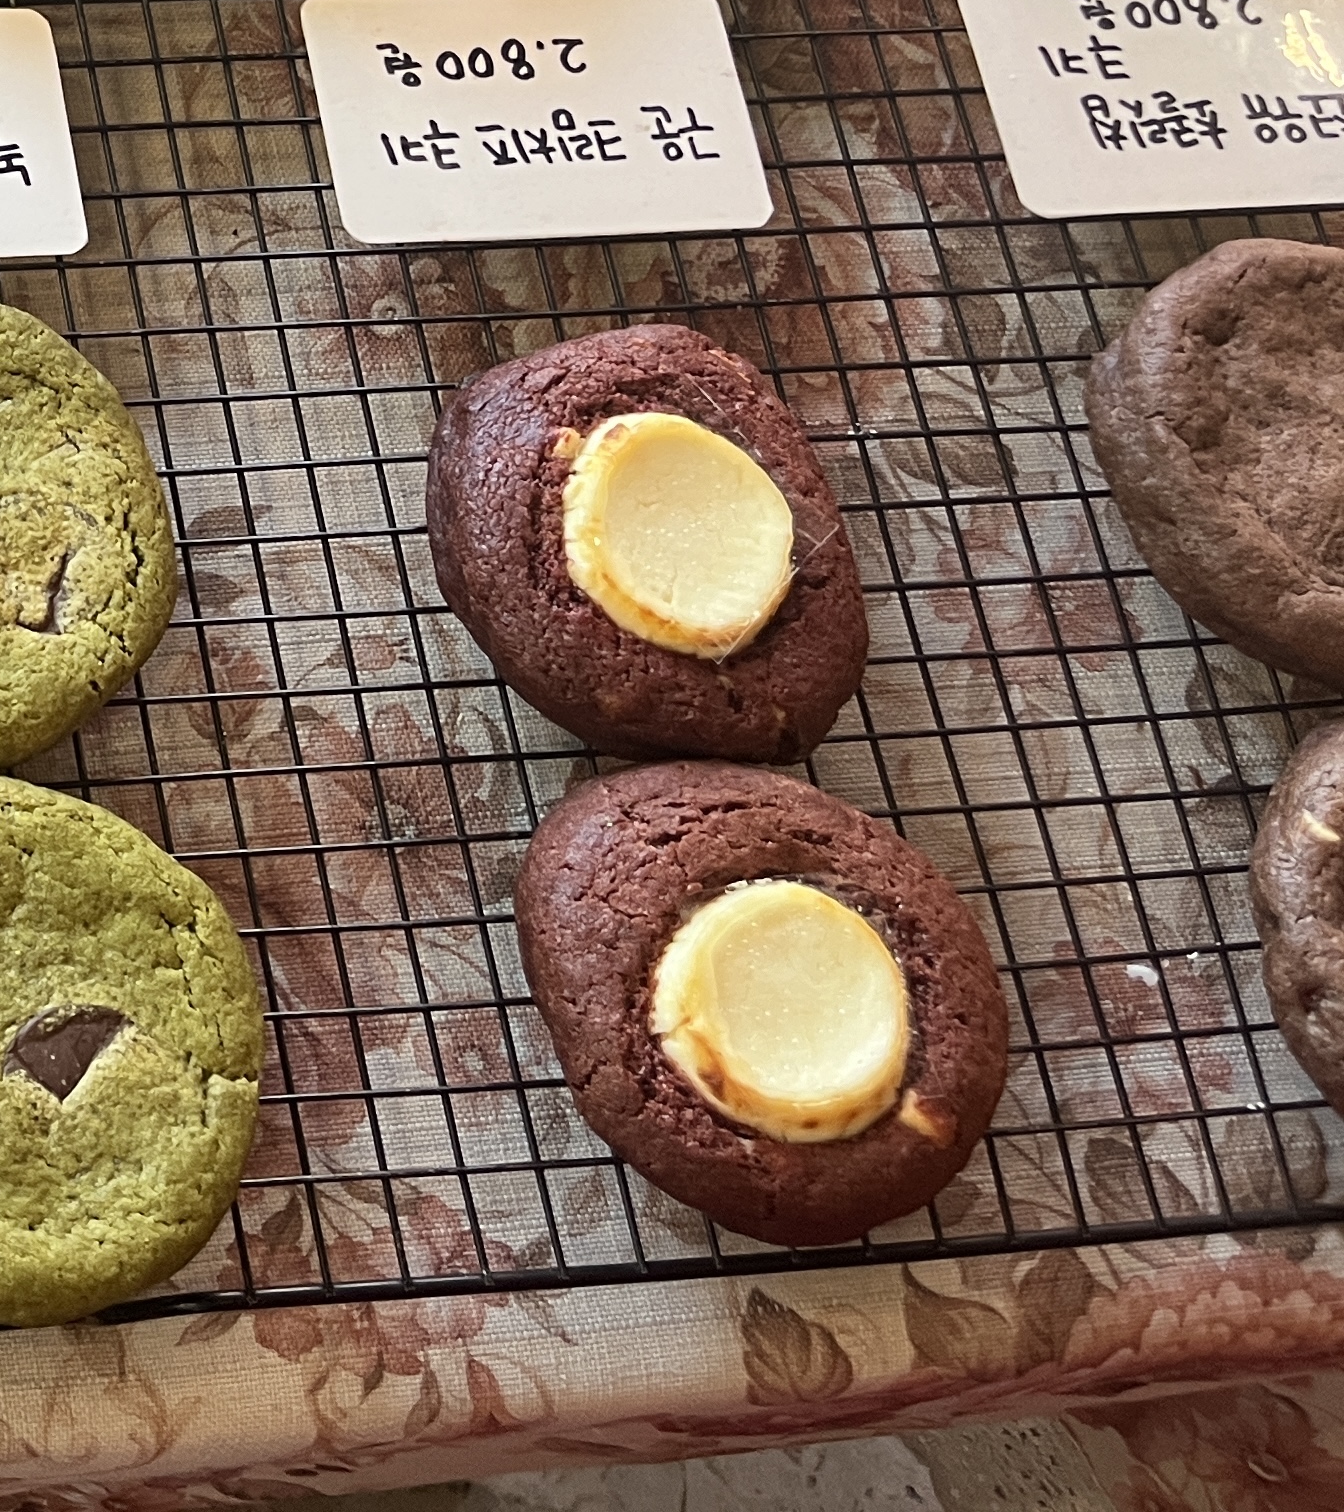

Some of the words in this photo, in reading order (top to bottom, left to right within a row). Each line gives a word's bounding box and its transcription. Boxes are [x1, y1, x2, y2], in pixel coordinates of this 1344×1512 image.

[1038, 35, 1130, 81] 쿠키
[381, 119, 460, 170] 쿠키
[475, 109, 627, 166] 크림치즈
[640, 106, 720, 162] 구운
[1081, 91, 1227, 151] 초콜릿칩
